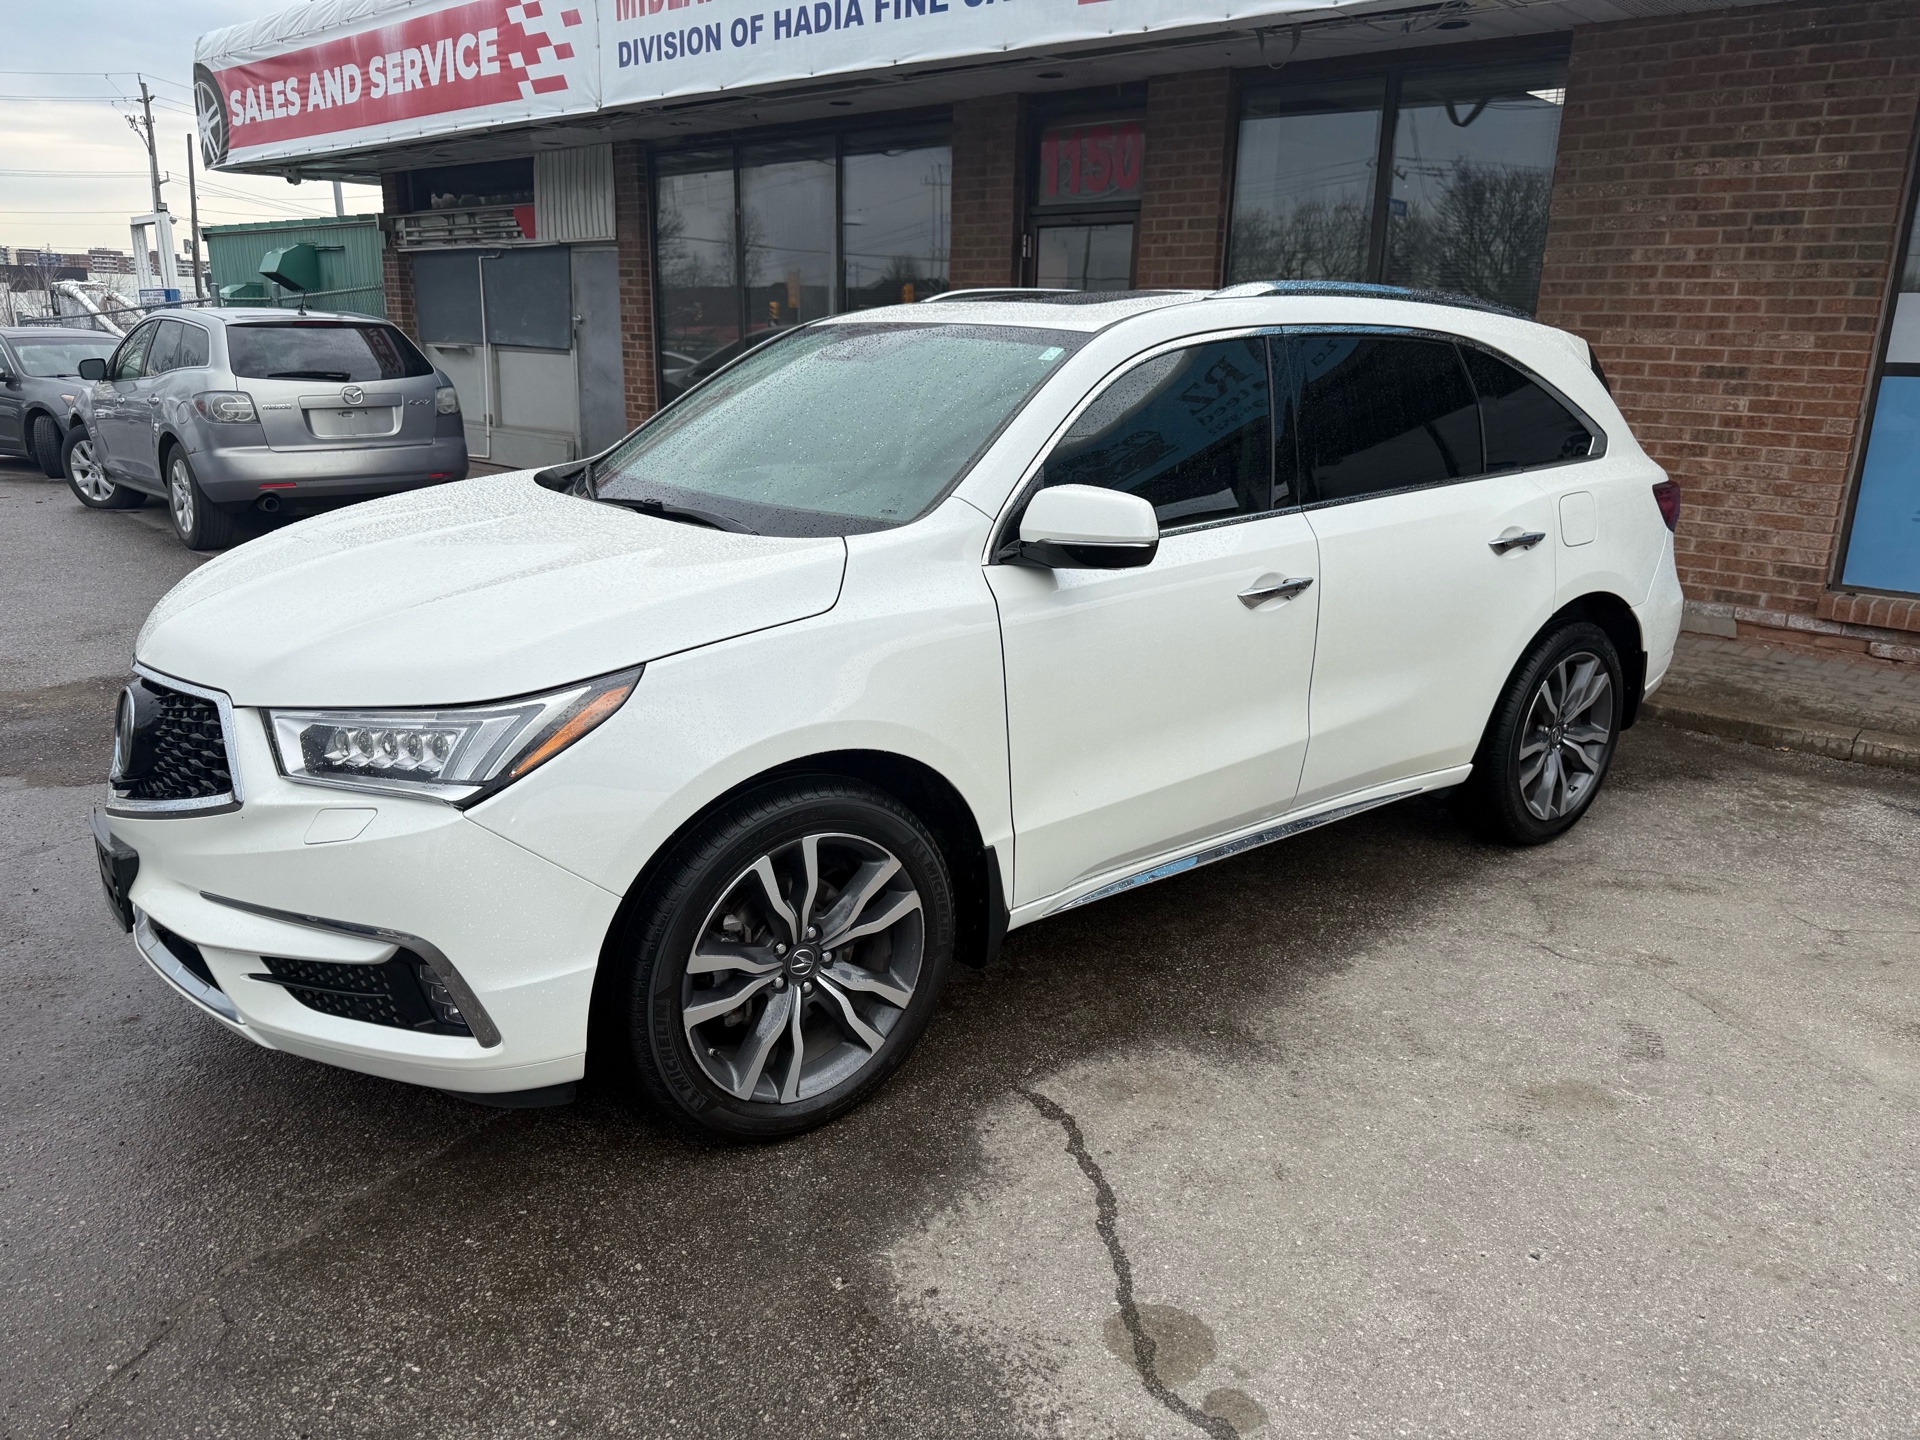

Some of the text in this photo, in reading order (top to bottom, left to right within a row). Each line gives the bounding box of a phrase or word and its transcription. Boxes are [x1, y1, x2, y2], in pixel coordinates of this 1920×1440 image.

[618, 22, 722, 68] DIVISION
[730, 14, 764, 47] OF
[774, 0, 864, 41] HADIA
[229, 27, 500, 127] SALES AND SERVICE
[1041, 122, 1142, 196] 1150
[924, 860, 949, 942] MICHELIN
[655, 1003, 692, 1092] MICHELIN
